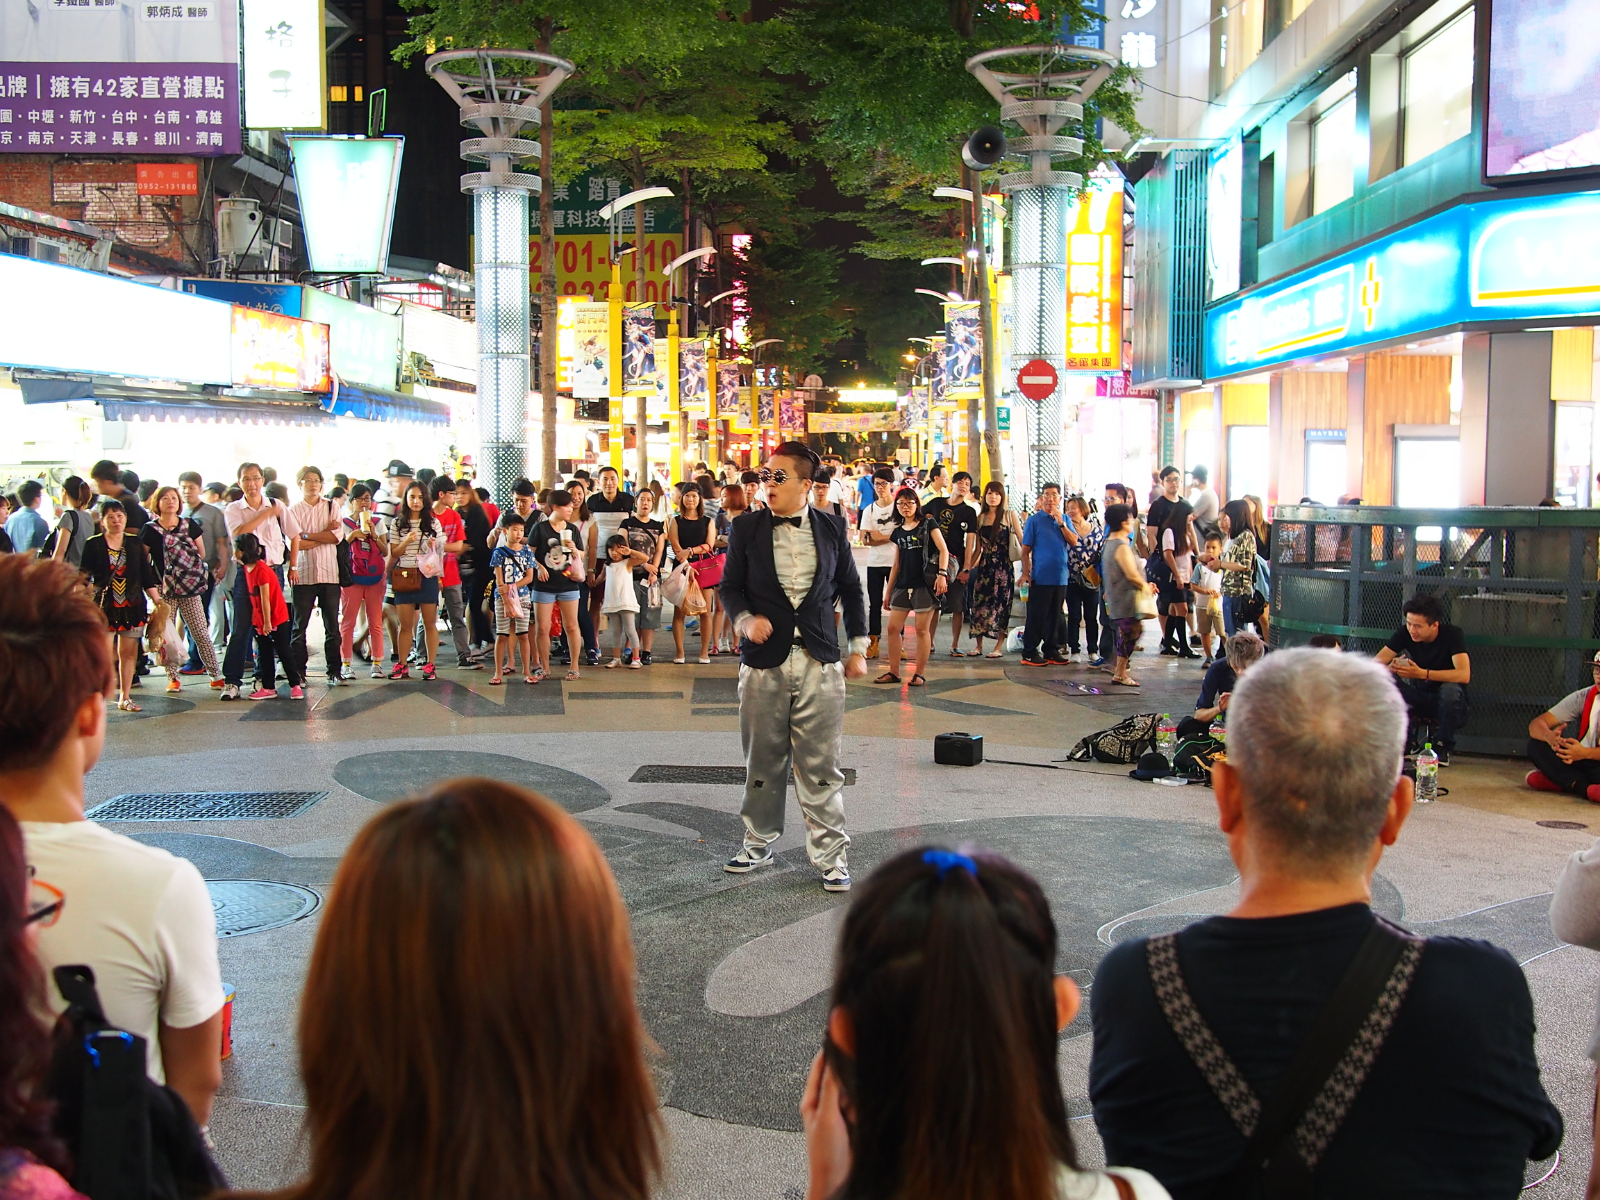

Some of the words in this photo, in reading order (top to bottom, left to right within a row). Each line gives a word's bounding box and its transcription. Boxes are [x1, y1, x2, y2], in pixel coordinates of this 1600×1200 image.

[147, 6, 183, 18] 郭炳成
[188, 7, 208, 18] 醫師
[264, 21, 294, 98] 格子
[0, 75, 27, 98] 牌
[609, 423, 621, 432] 12
[1310, 430, 1347, 438] MAYBEL
